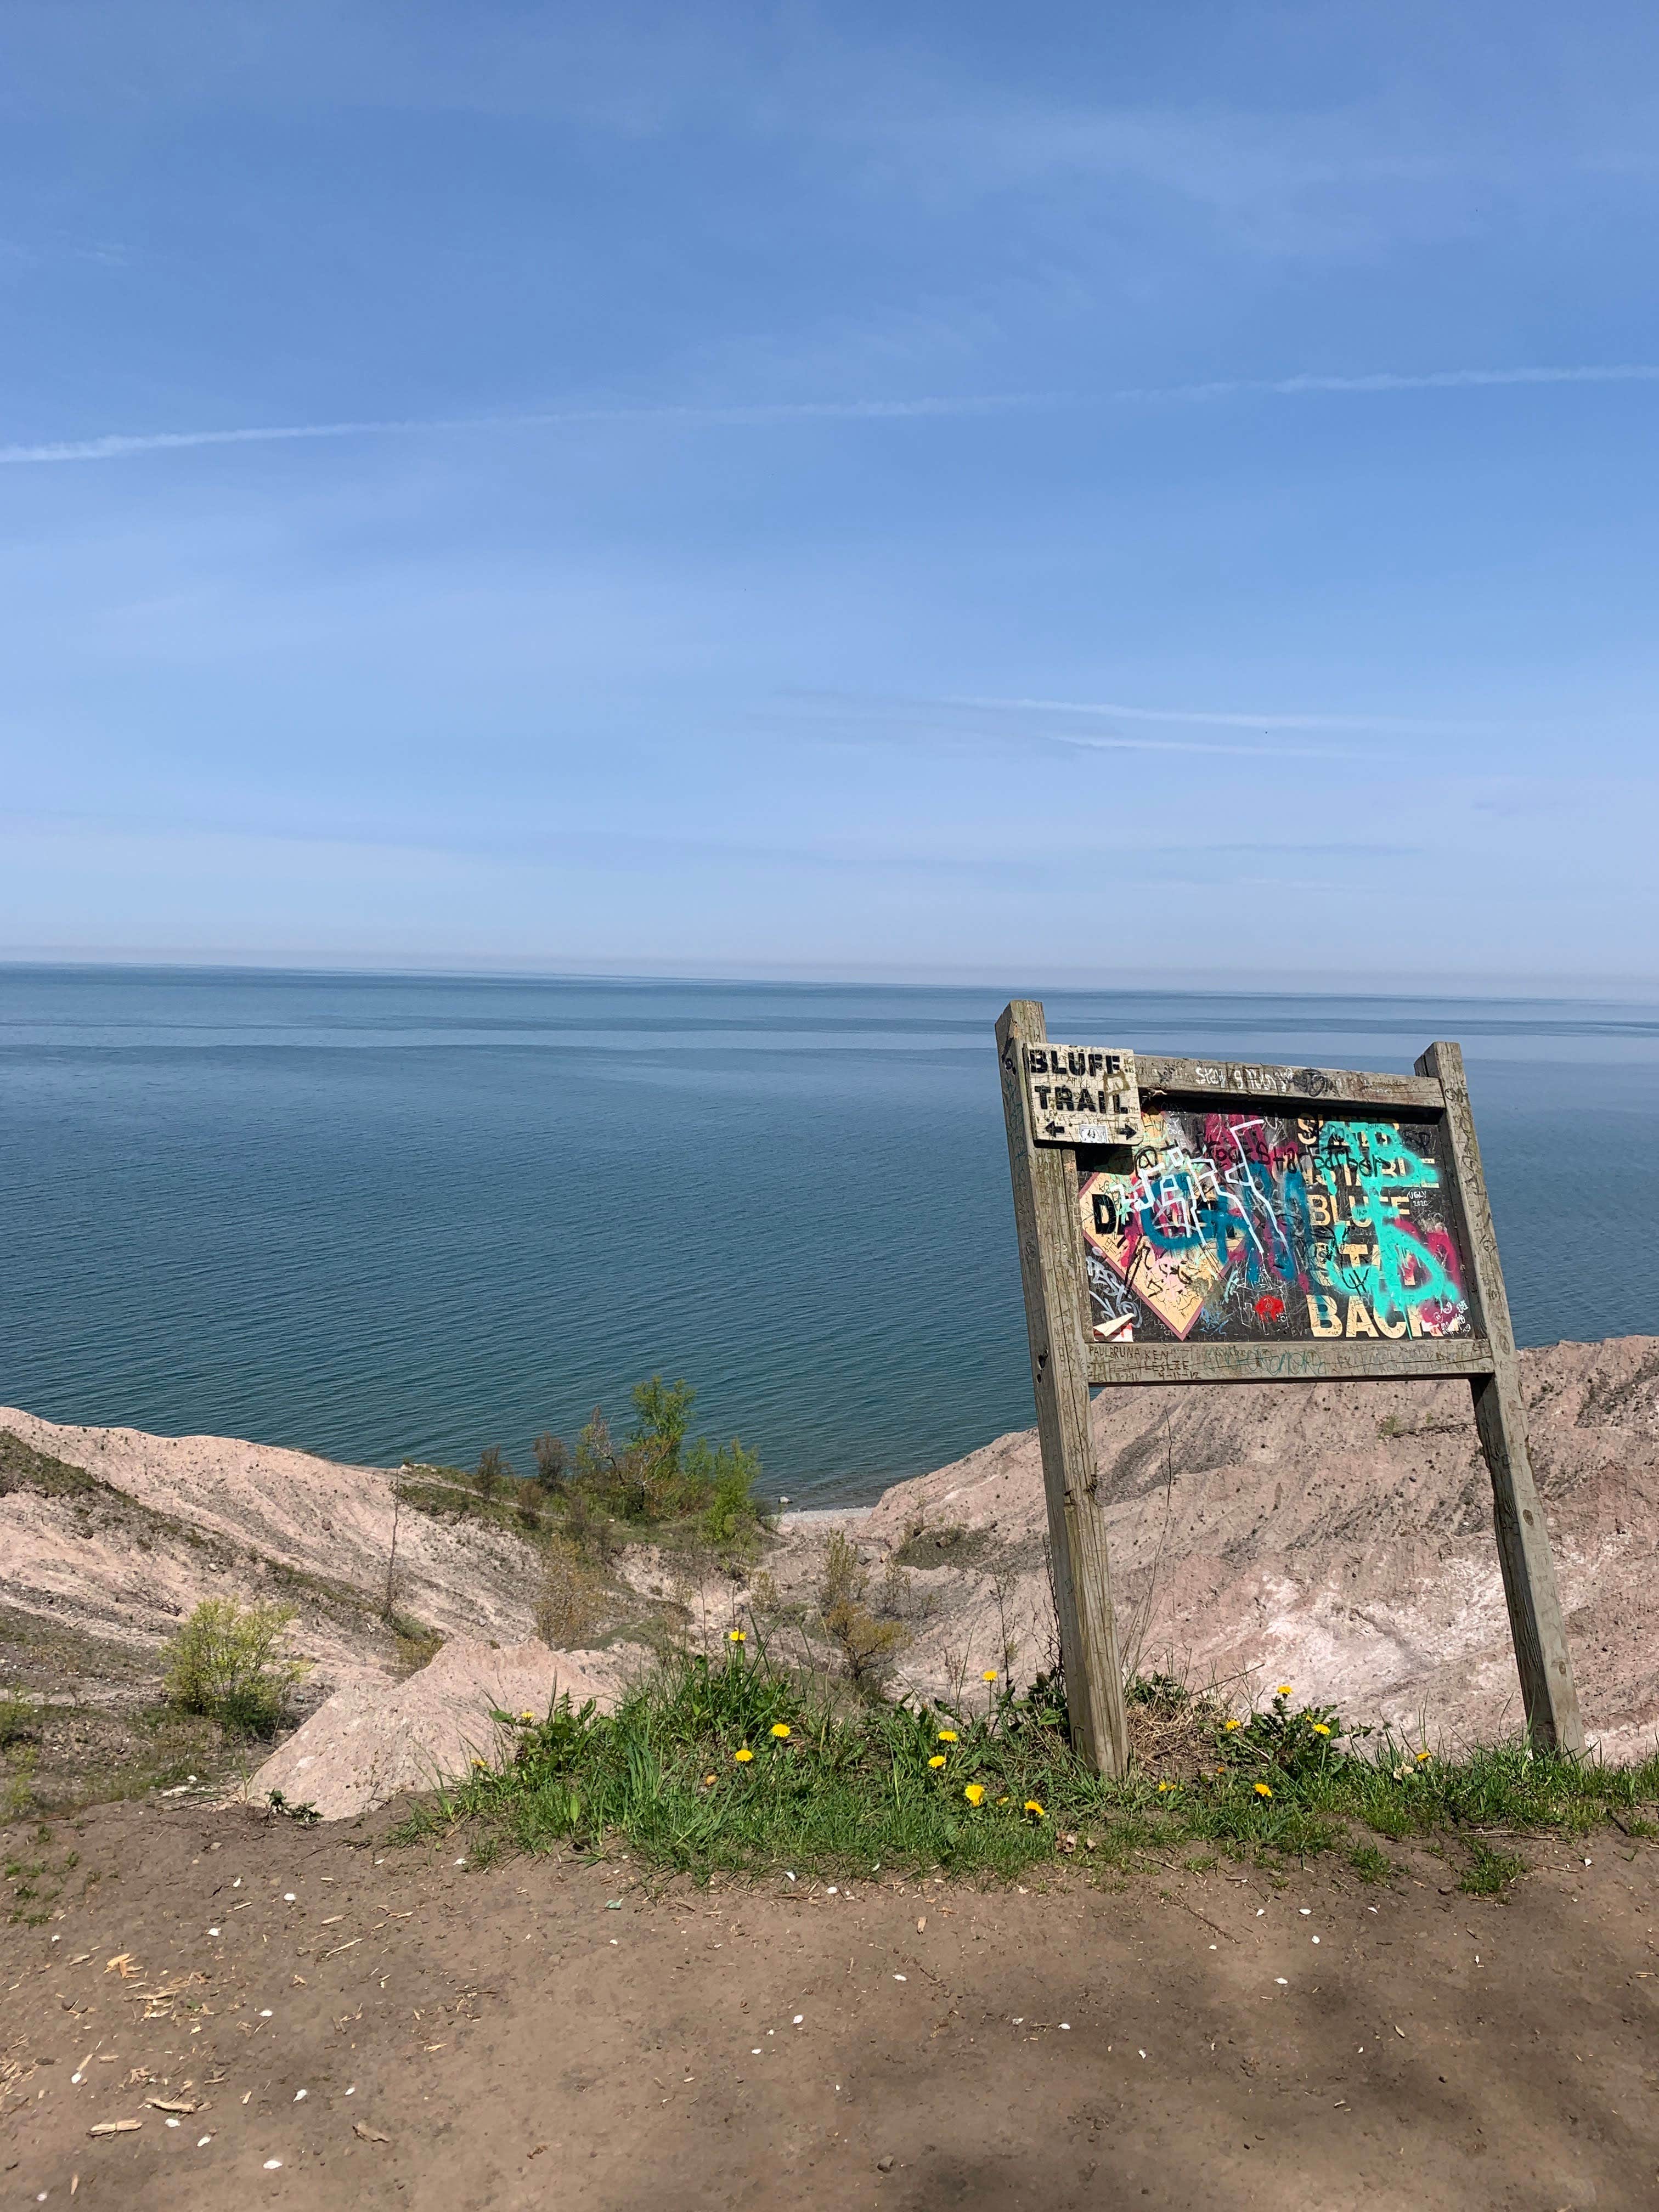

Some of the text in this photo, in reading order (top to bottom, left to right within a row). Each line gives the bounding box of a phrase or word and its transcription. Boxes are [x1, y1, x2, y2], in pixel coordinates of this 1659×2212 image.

[1029, 1048, 1120, 1077] BLUFF
[1034, 1085, 1128, 1114] TRAIL
[1408, 1190, 1427, 1199] UGLY
[1307, 1194, 1410, 1228] BLUF
[1306, 1294, 1445, 1339] BACK
